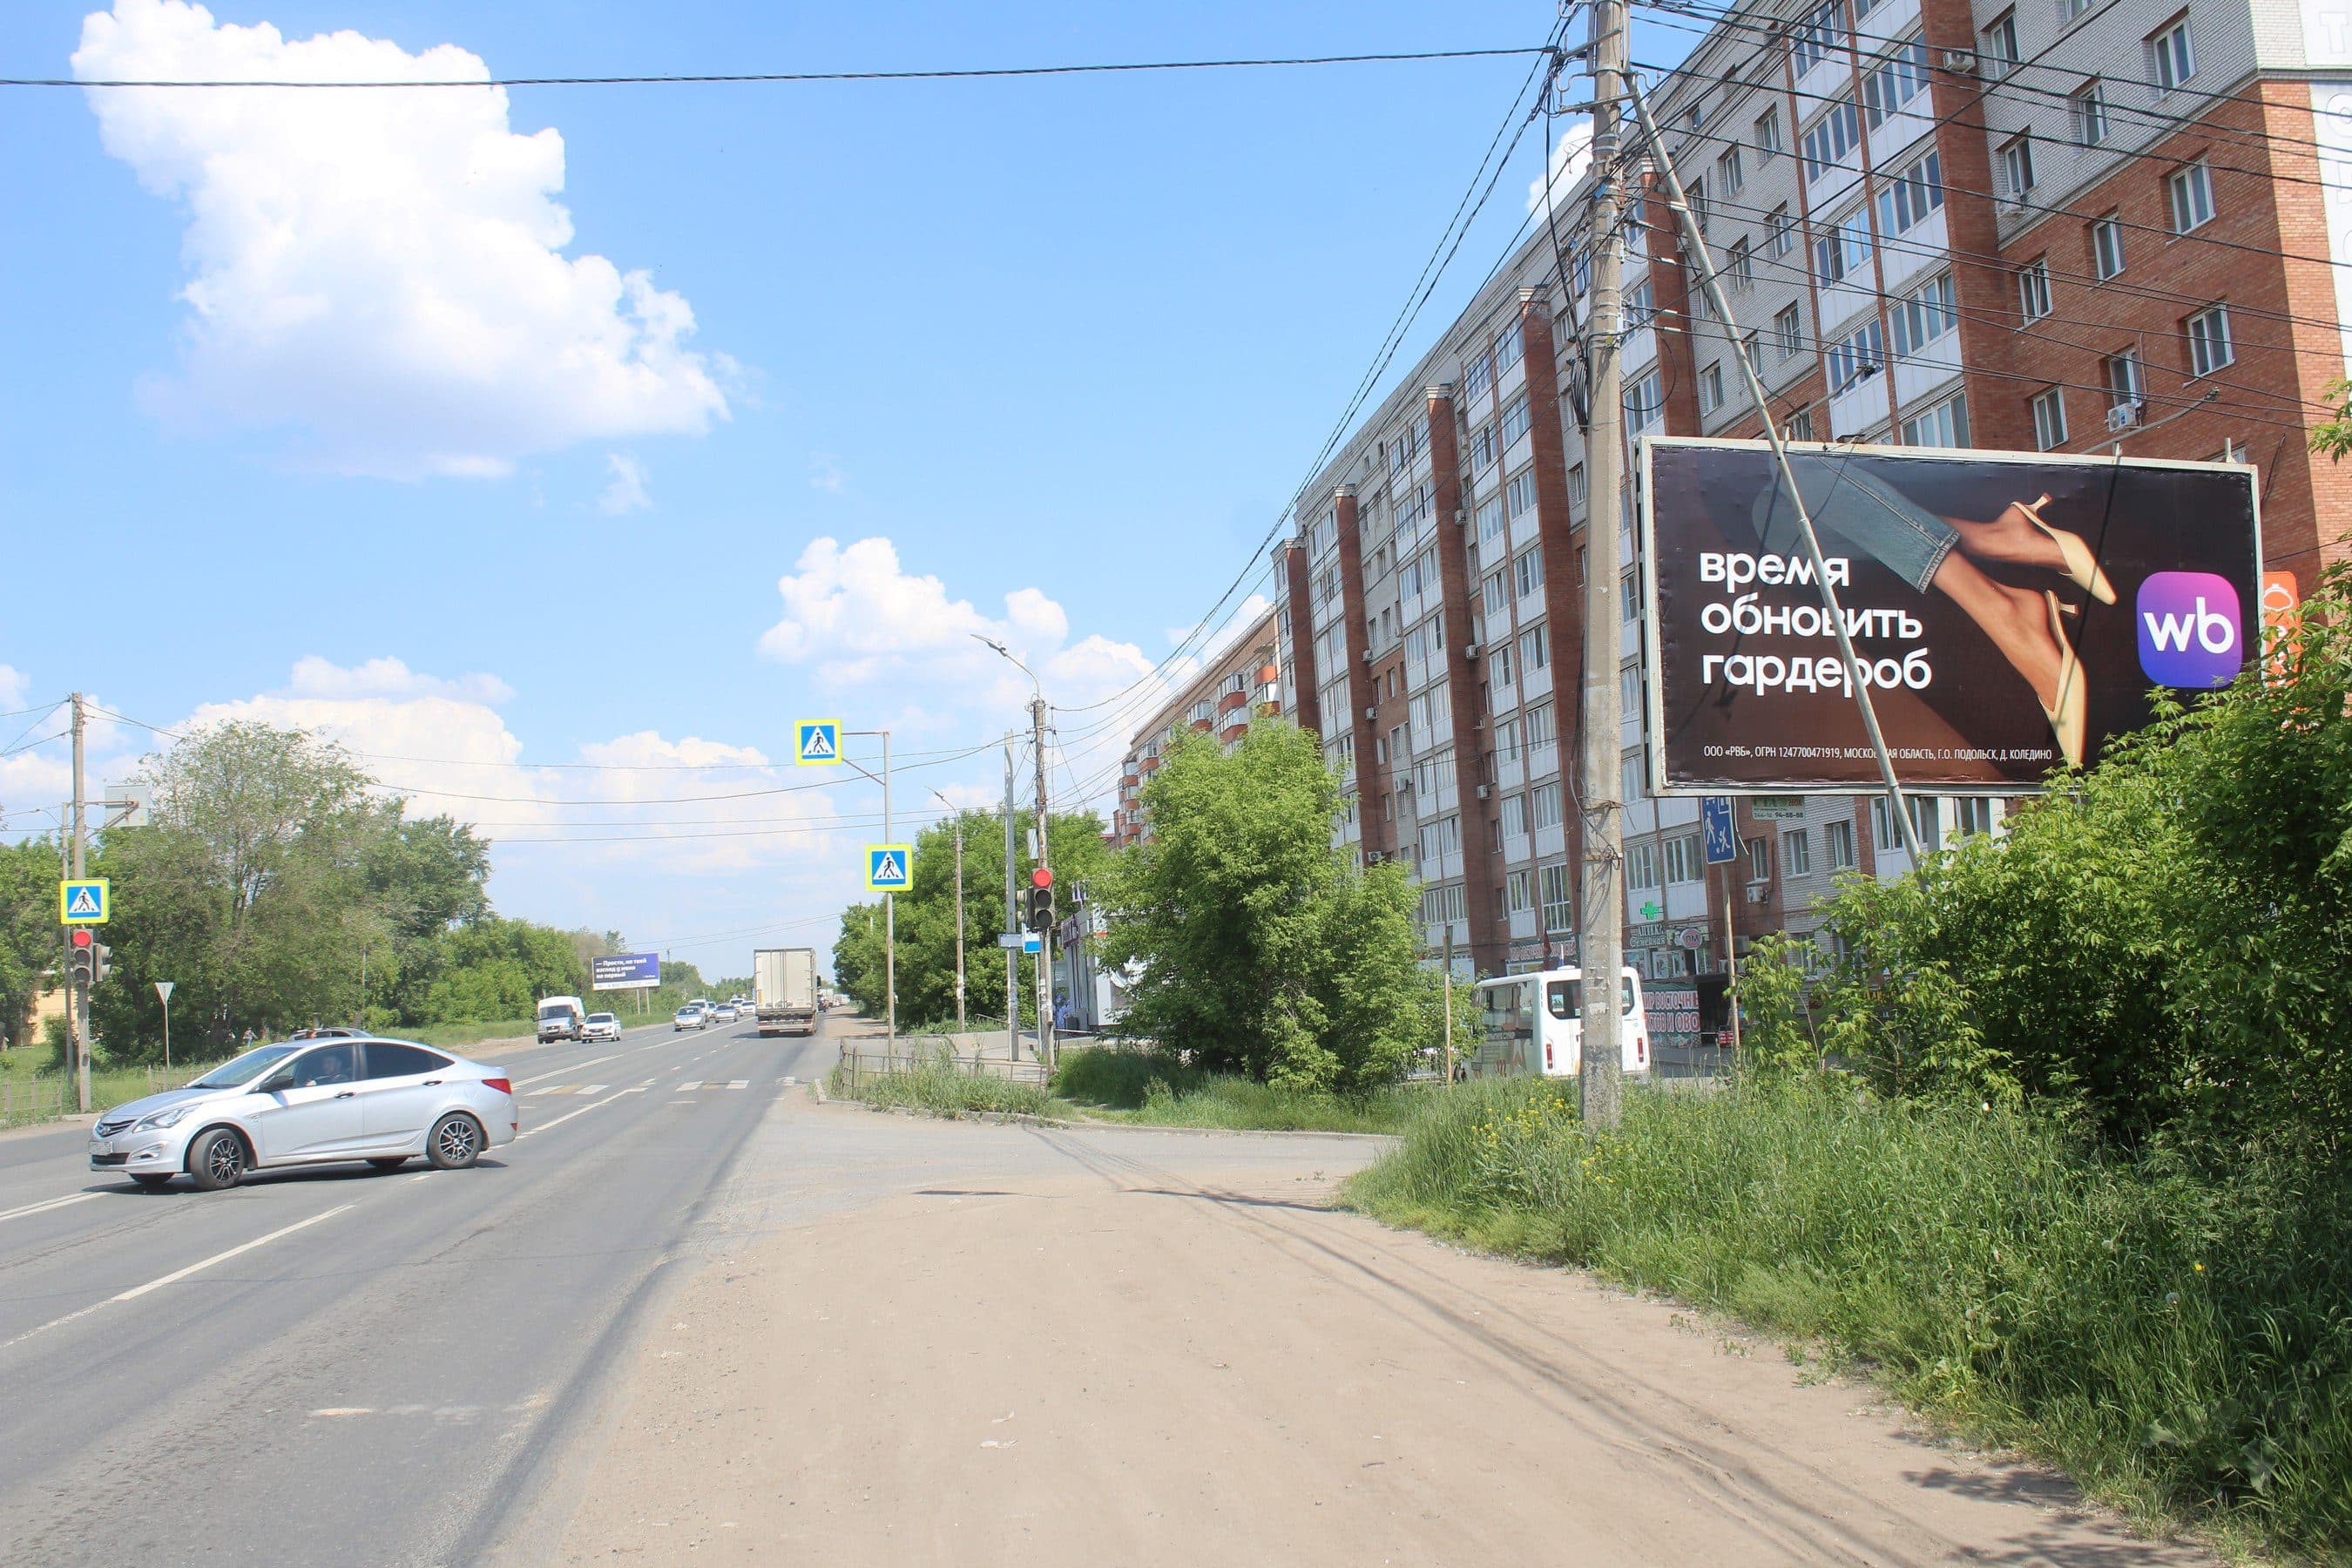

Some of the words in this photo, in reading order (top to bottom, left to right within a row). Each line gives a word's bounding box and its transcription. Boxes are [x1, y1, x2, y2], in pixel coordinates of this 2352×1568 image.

[1700, 552, 1849, 593] время
[1701, 592, 1923, 639] обновить
[2143, 597, 2234, 653] wb
[1702, 647, 1932, 698] гардероб
[1704, 746, 1723, 757] ООО
[1725, 747, 1753, 758] «РВБ»,
[1754, 747, 1776, 757] ОГРН
[1779, 747, 1842, 759] 1247700471919,
[1844, 747, 1897, 759] МОСКОАЯ
[1899, 748, 1936, 760] ОБЛАСТЬ,
[1937, 749, 1951, 760] Г.О.
[1954, 749, 1997, 760] ПОДОЛЬСК,
[2010, 749, 2051, 761] КОЛЕДИНО
